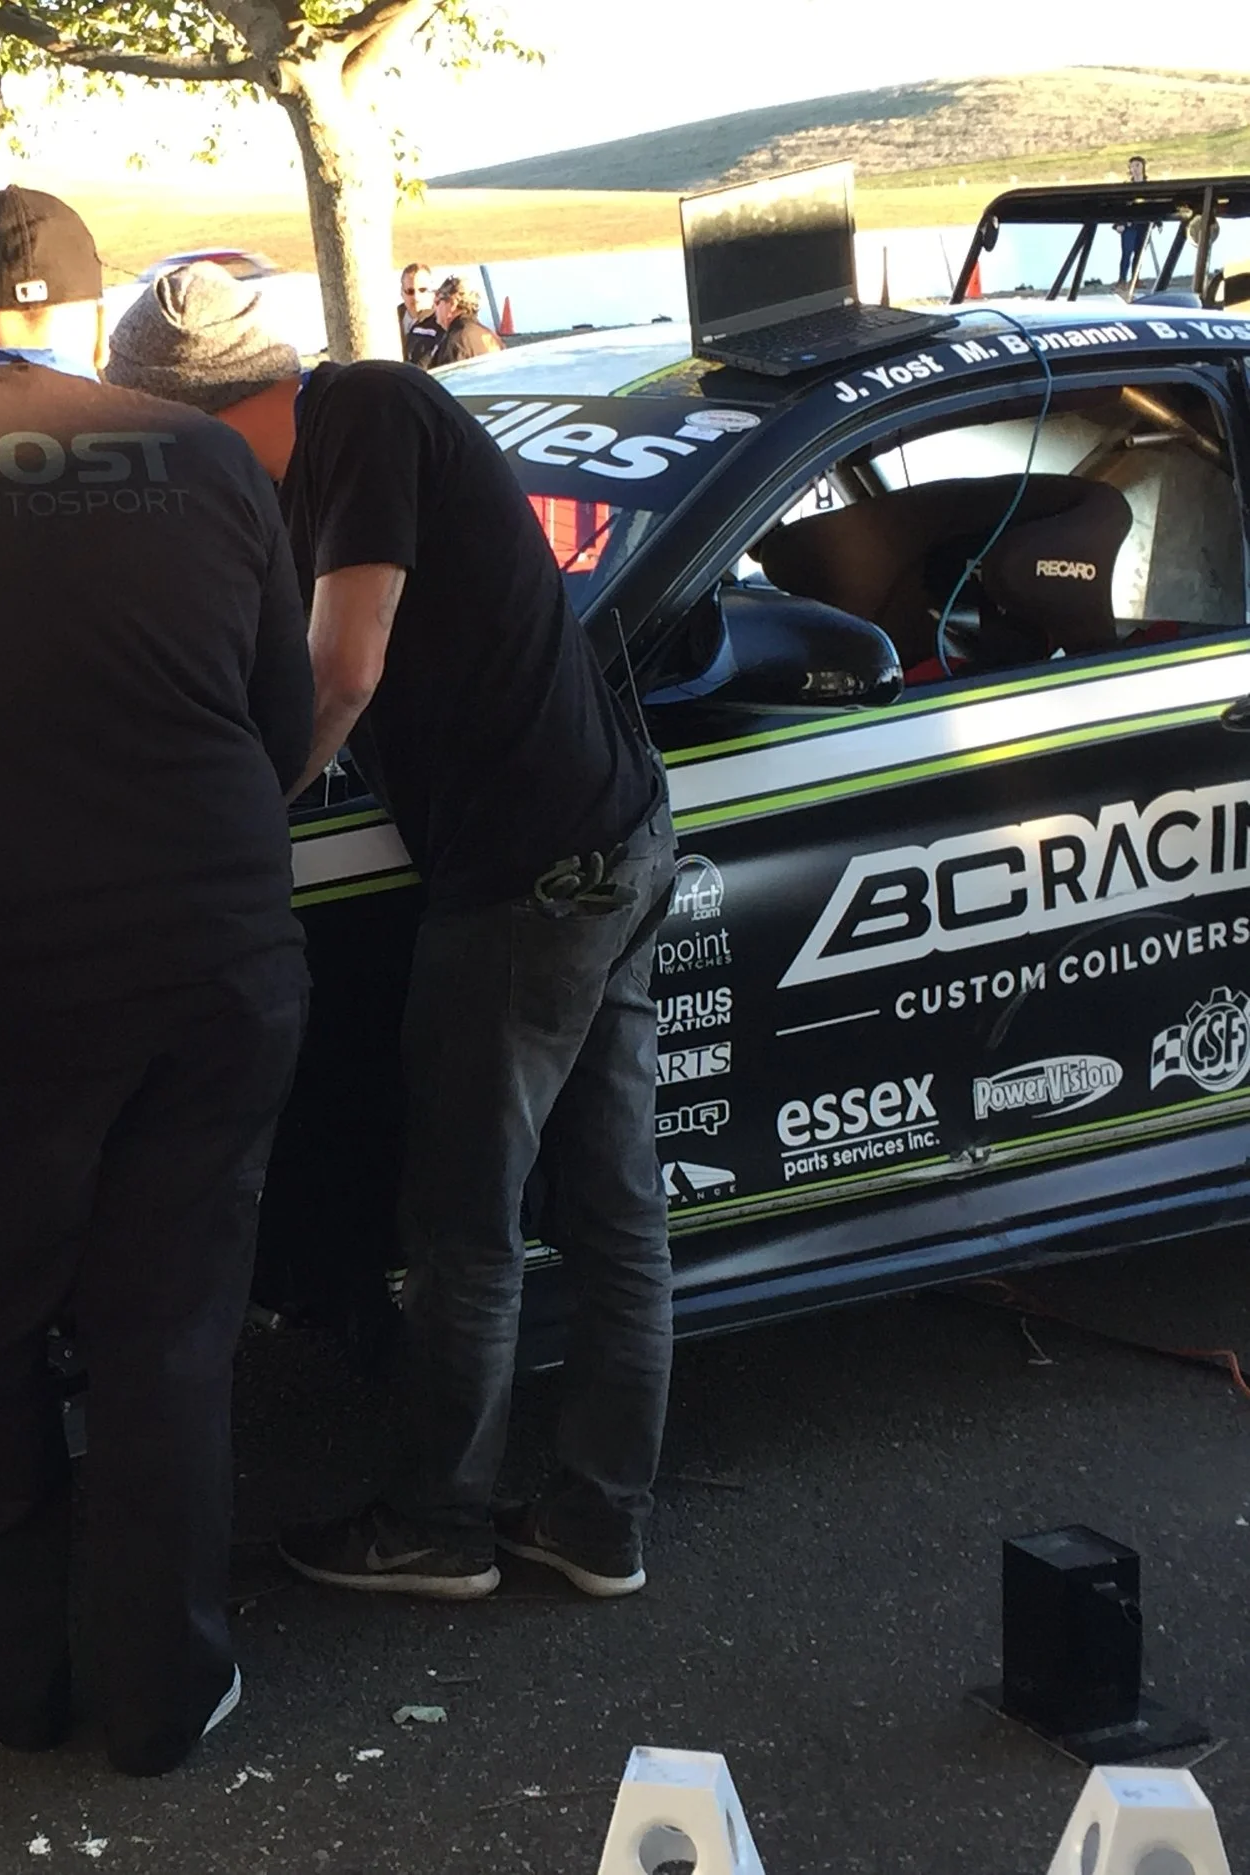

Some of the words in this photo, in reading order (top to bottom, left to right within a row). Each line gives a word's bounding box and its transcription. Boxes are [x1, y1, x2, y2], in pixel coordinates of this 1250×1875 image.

[835, 381, 870, 403] J.
[863, 354, 945, 391] Yost
[951, 338, 999, 364] M.
[999, 321, 1138, 355] Bonanni
[1146, 321, 1190, 340] B.
[1186, 321, 1250, 340] Yos
[1036, 559, 1097, 581] RECARO
[669, 884, 720, 915] trict
[665, 955, 733, 975] WATCHES
[894, 962, 1046, 1019] CUSTOM
[1059, 916, 1250, 985] COILOVERS
[1187, 1009, 1242, 1072] CSF
[777, 1073, 938, 1147] essex
[973, 1058, 1118, 1121] PowerVision
[784, 1152, 829, 1181] parts
[833, 1137, 905, 1167] services
[907, 1129, 941, 1151] inc.
